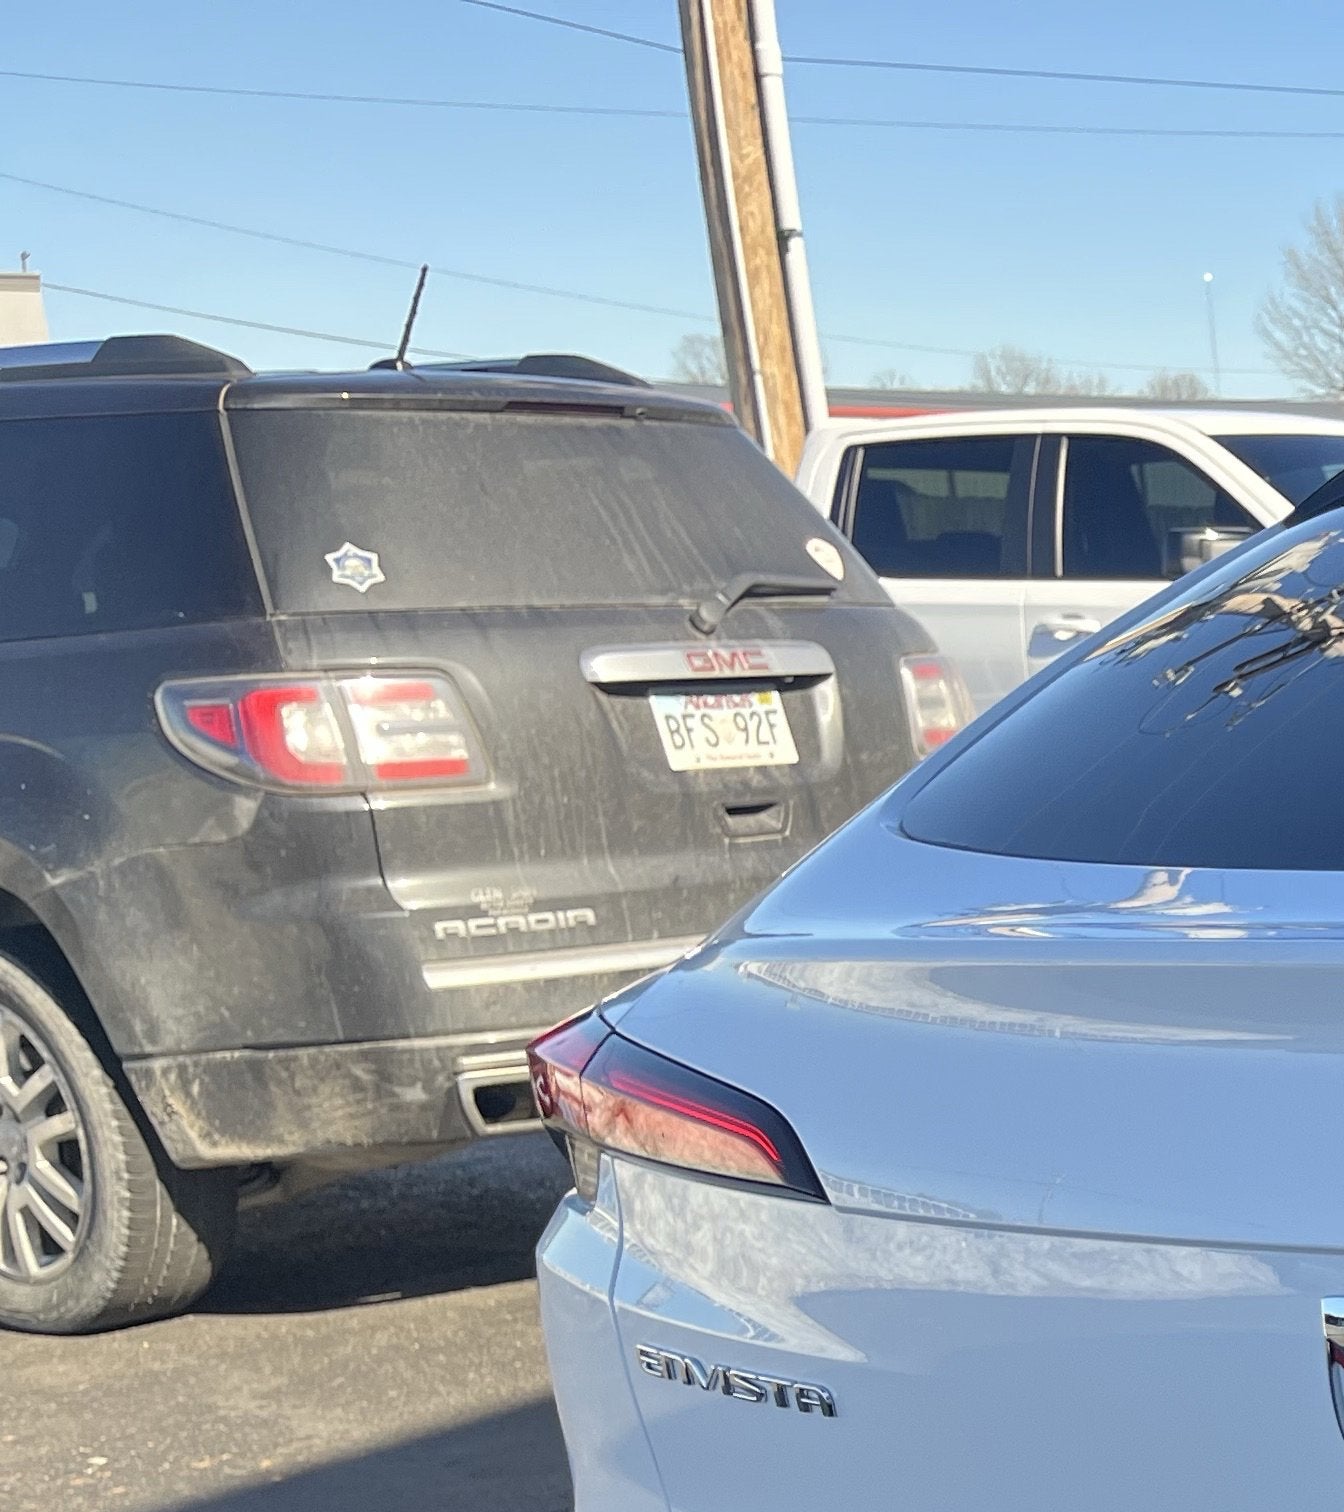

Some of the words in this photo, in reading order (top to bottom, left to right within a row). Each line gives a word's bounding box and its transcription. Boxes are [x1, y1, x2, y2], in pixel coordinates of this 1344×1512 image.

[684, 650, 769, 672] GMC
[664, 710, 720, 750] BFS
[733, 709, 778, 747] 92F
[434, 907, 597, 941] ACADIA
[636, 1343, 838, 1418] ENVISTA
